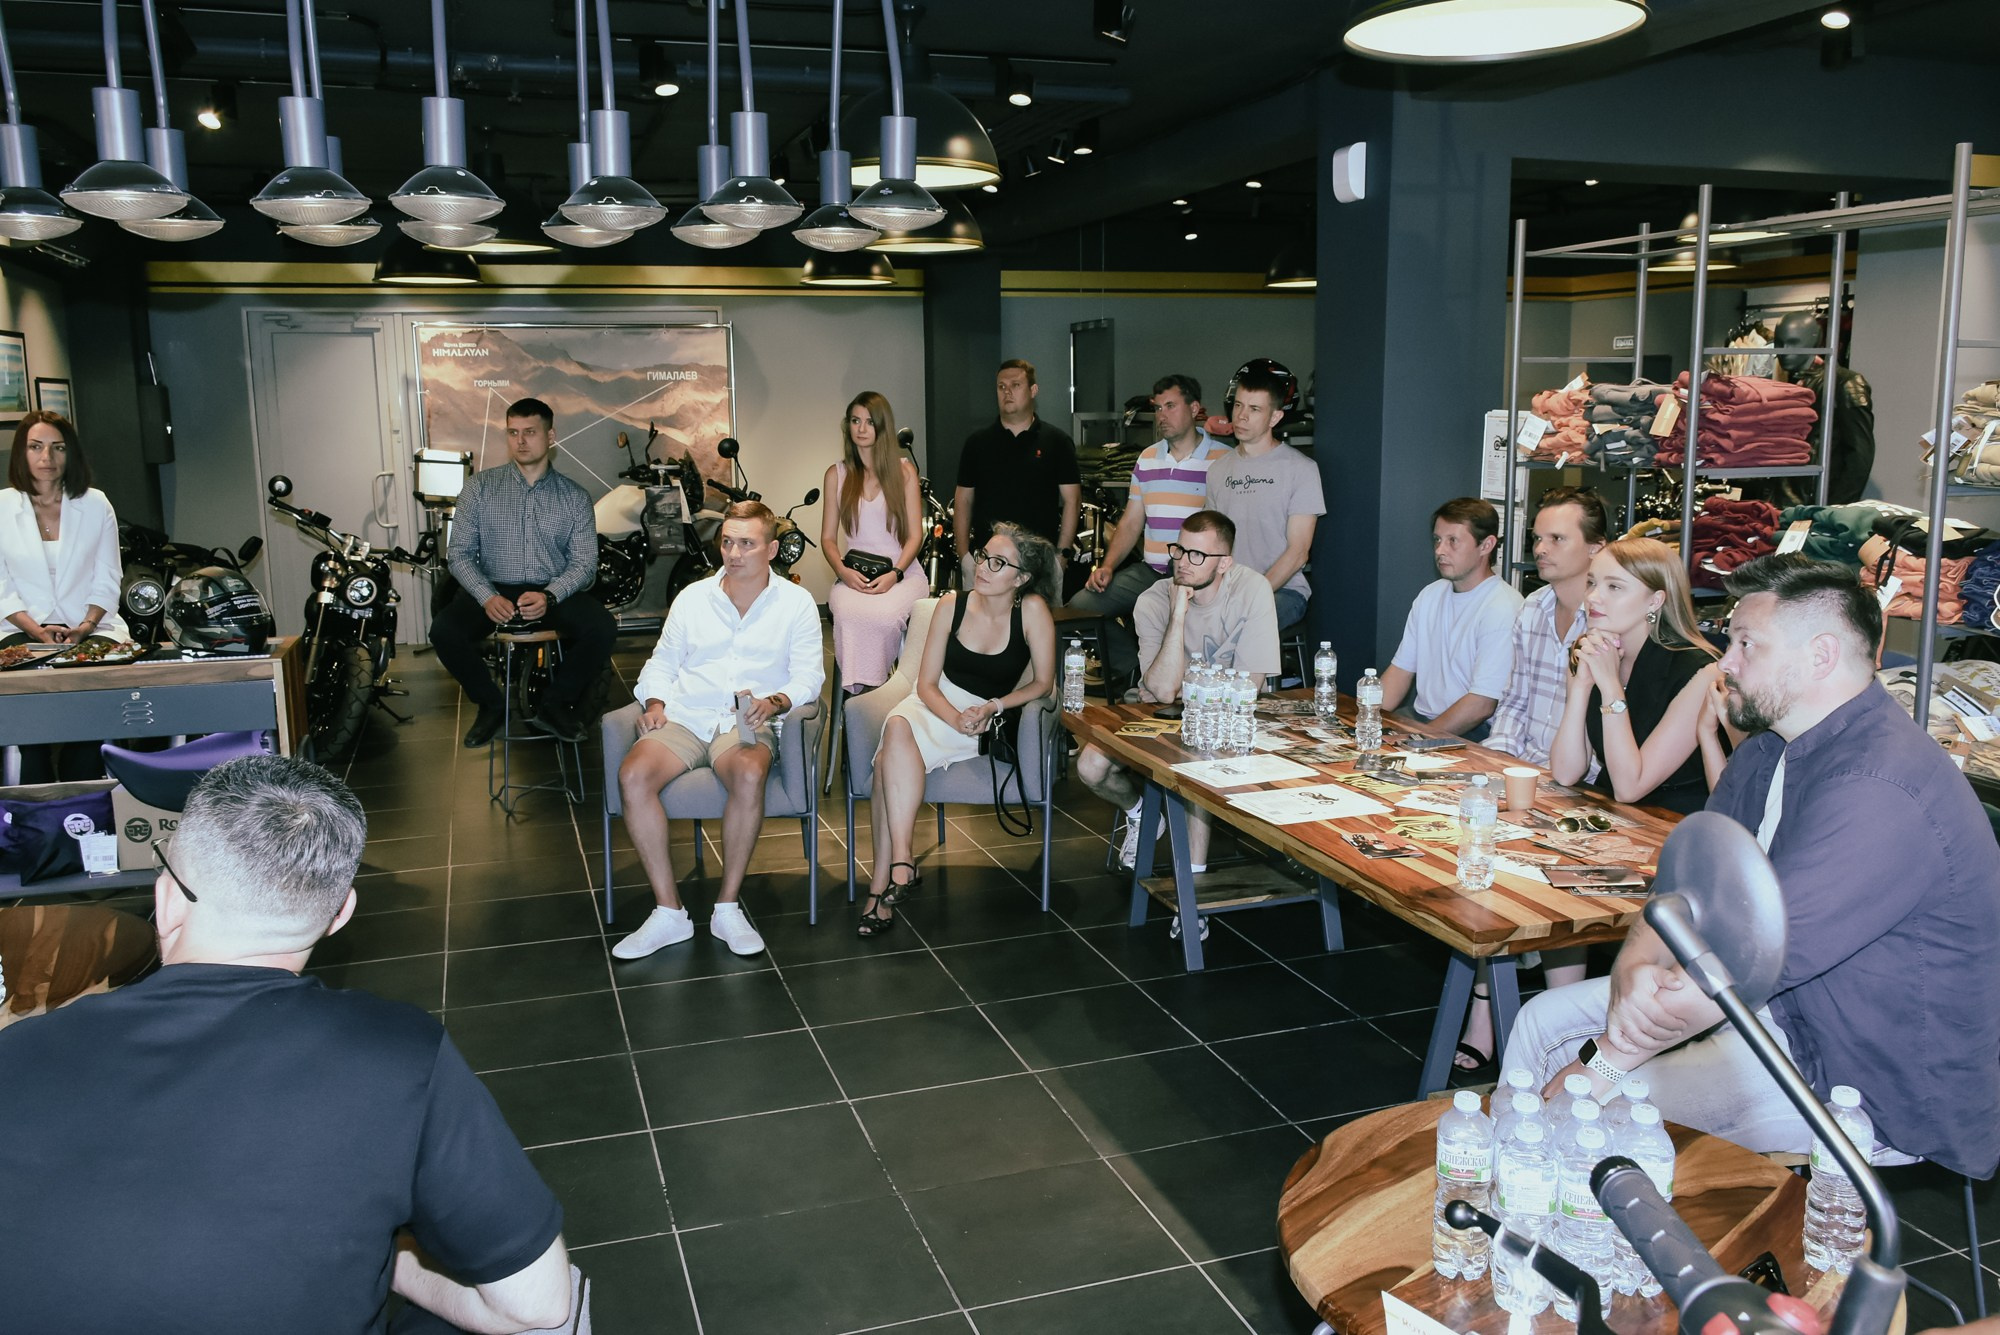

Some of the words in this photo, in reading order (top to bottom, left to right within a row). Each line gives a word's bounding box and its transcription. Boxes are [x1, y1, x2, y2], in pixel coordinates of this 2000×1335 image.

[432, 348, 489, 357] HIMALAYAN
[646, 371, 698, 381] ГИМАЛАЕВ
[473, 380, 510, 388] ГОРНЫМИ
